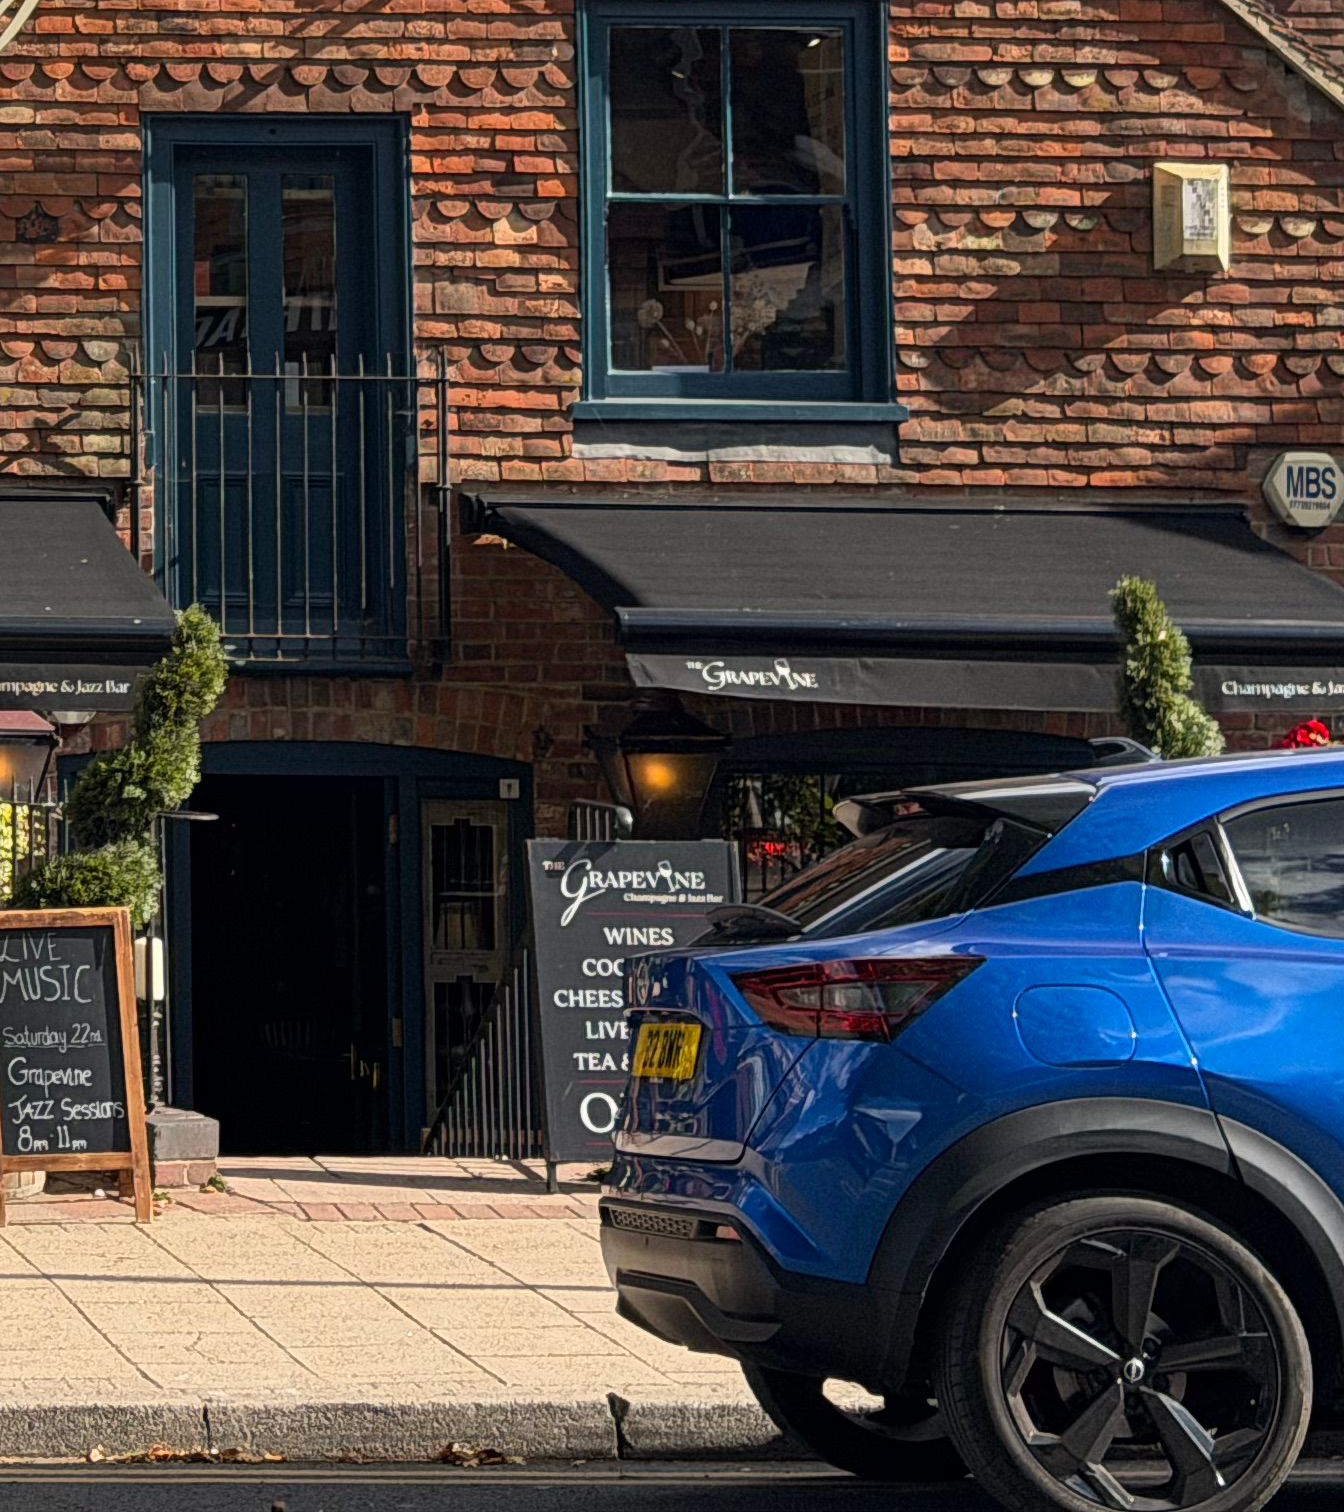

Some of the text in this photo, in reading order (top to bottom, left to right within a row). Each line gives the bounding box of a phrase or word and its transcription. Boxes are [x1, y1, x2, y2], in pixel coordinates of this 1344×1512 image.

[1286, 465, 1337, 499] MBS
[60, 679, 75, 693] &
[75, 679, 104, 695] Jazz
[105, 679, 131, 694] Bar
[1221, 680, 1310, 699] Champagne
[1312, 680, 1327, 695] &
[603, 927, 674, 946] WINES
[2, 1026, 68, 1053] Saturday
[573, 1052, 617, 1072] TEA
[7, 1056, 93, 1098] Grapevine
[8, 1094, 125, 1124] JAZZ Sessions
